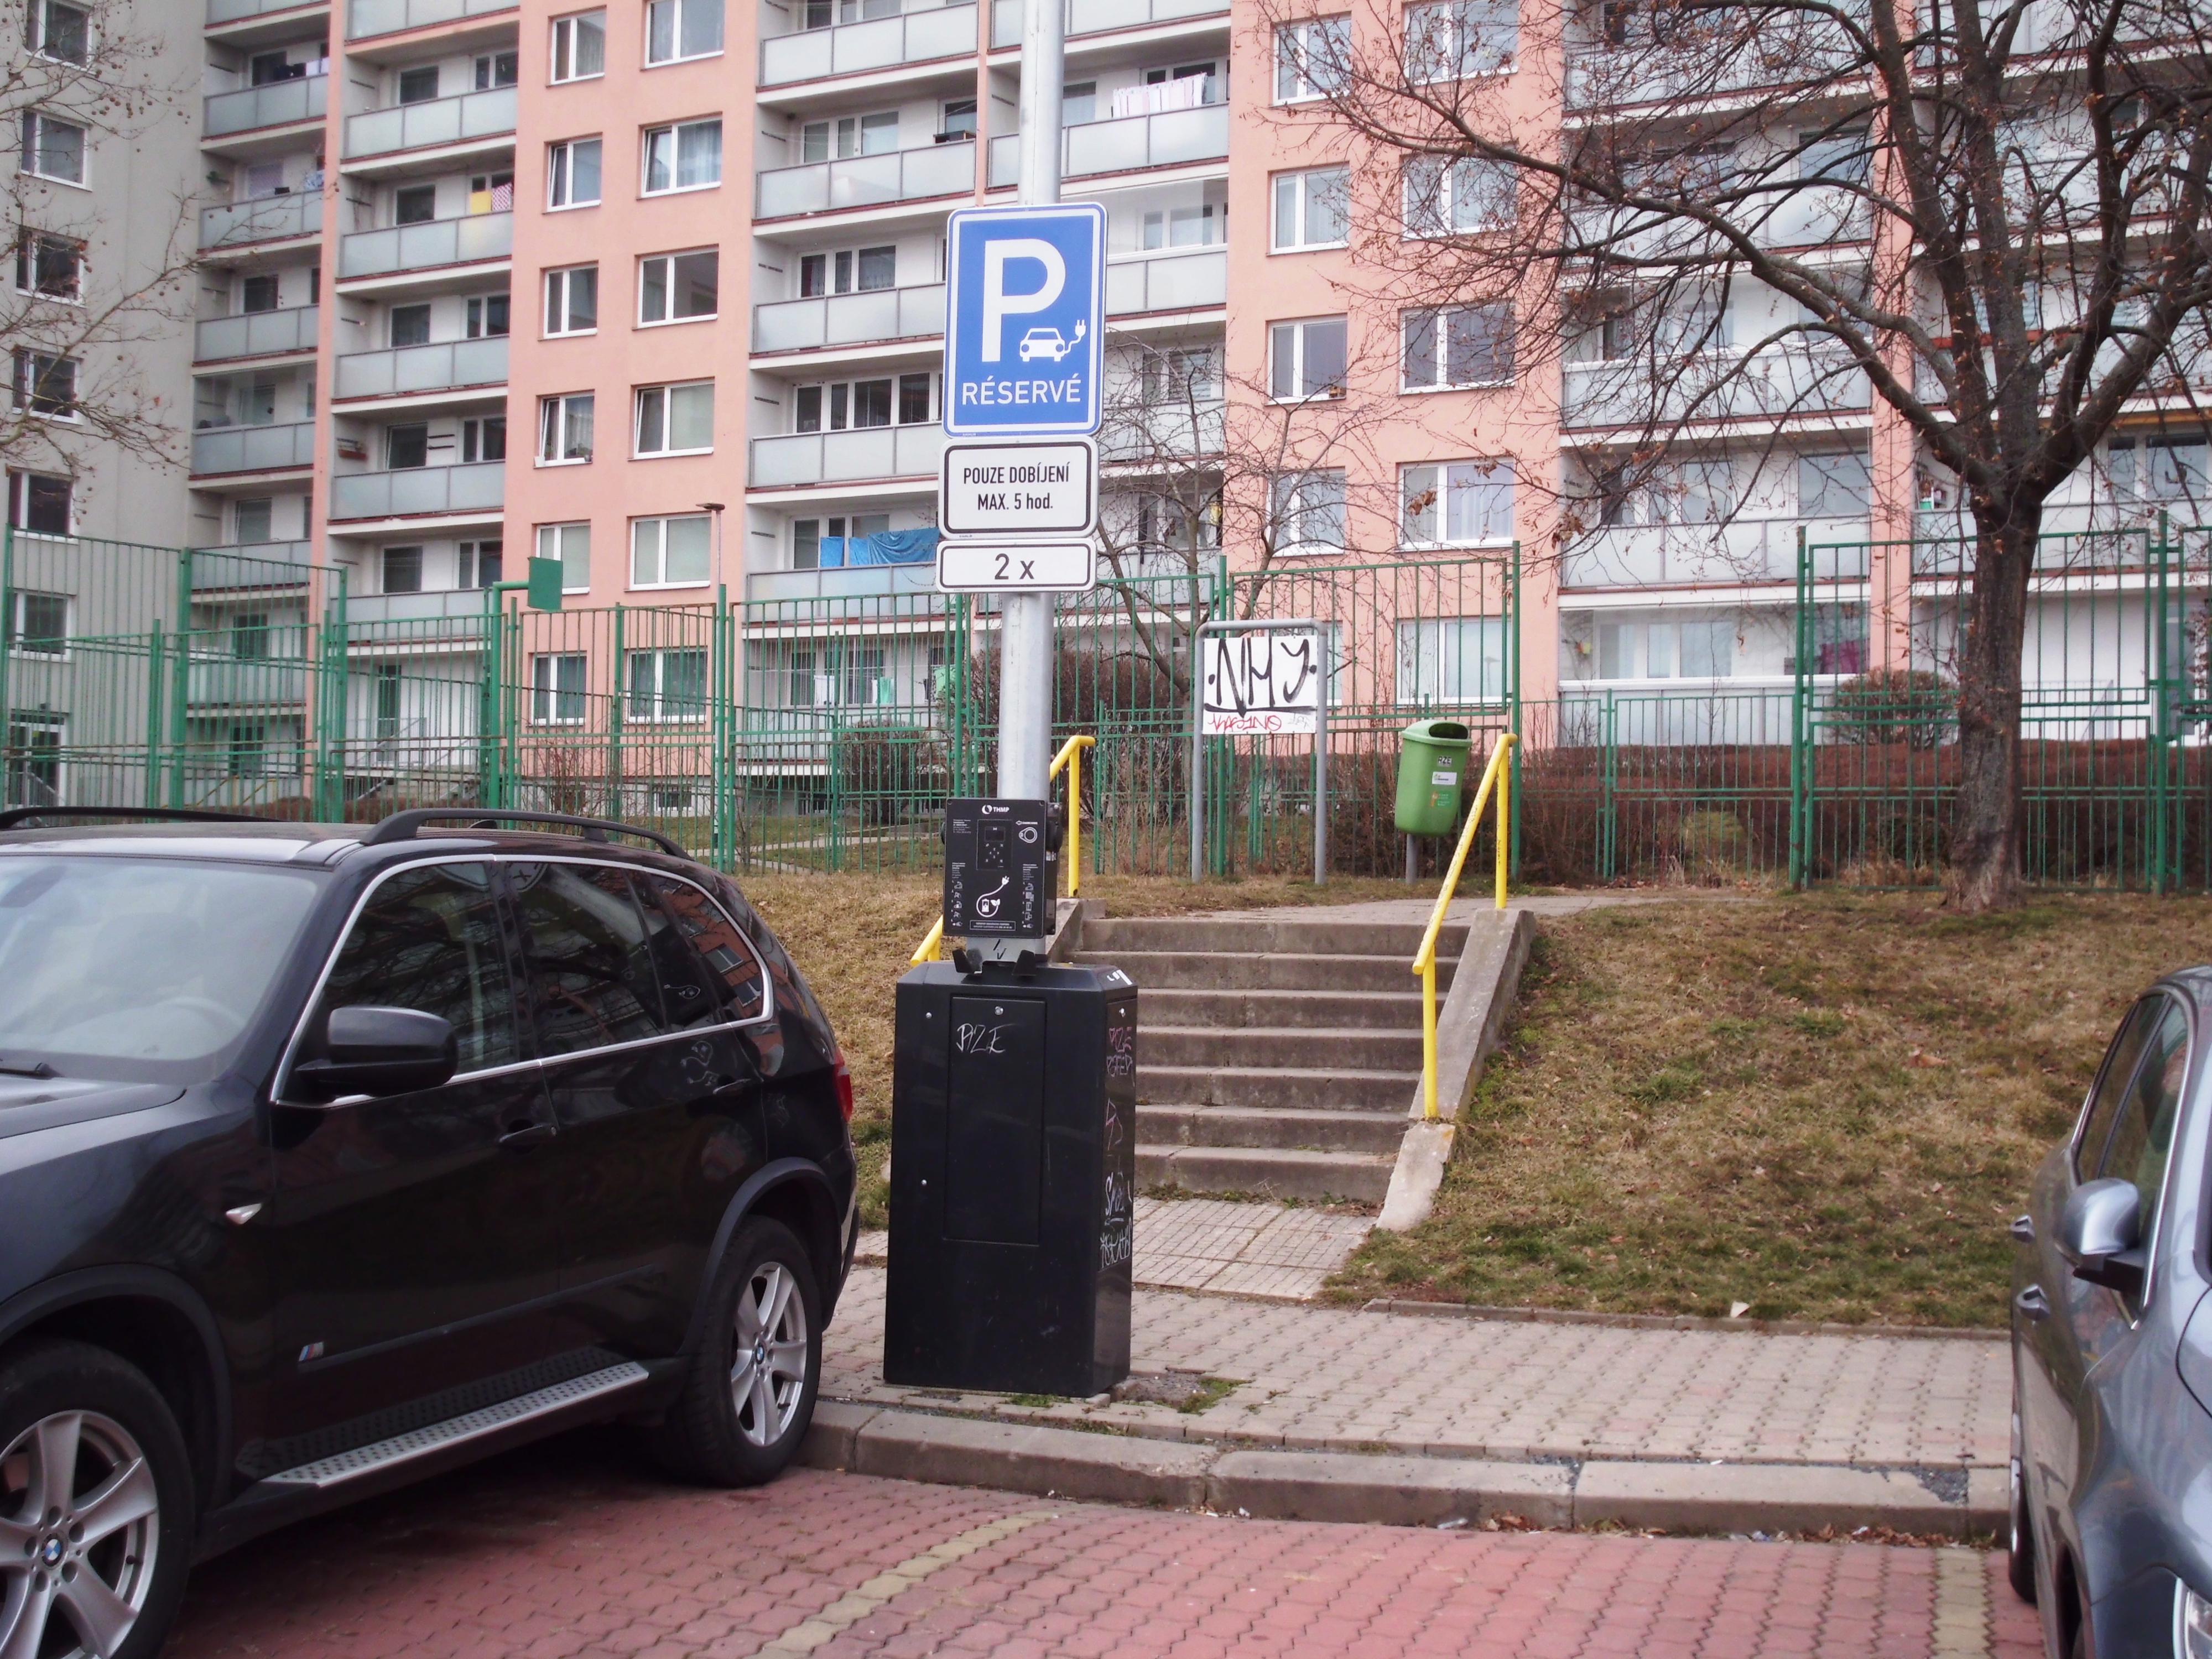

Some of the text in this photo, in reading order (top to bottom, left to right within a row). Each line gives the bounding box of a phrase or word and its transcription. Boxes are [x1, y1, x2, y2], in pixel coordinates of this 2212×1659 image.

[981, 238, 1066, 362] P
[962, 373, 1081, 405] RÉSERVÉ
[963, 461, 1070, 484] POUZE DOBÍJENÍ
[977, 492, 1053, 510] MAX. 5 hod.
[994, 553, 1035, 580] 2 x
[1438, 756, 1452, 764] RZE
